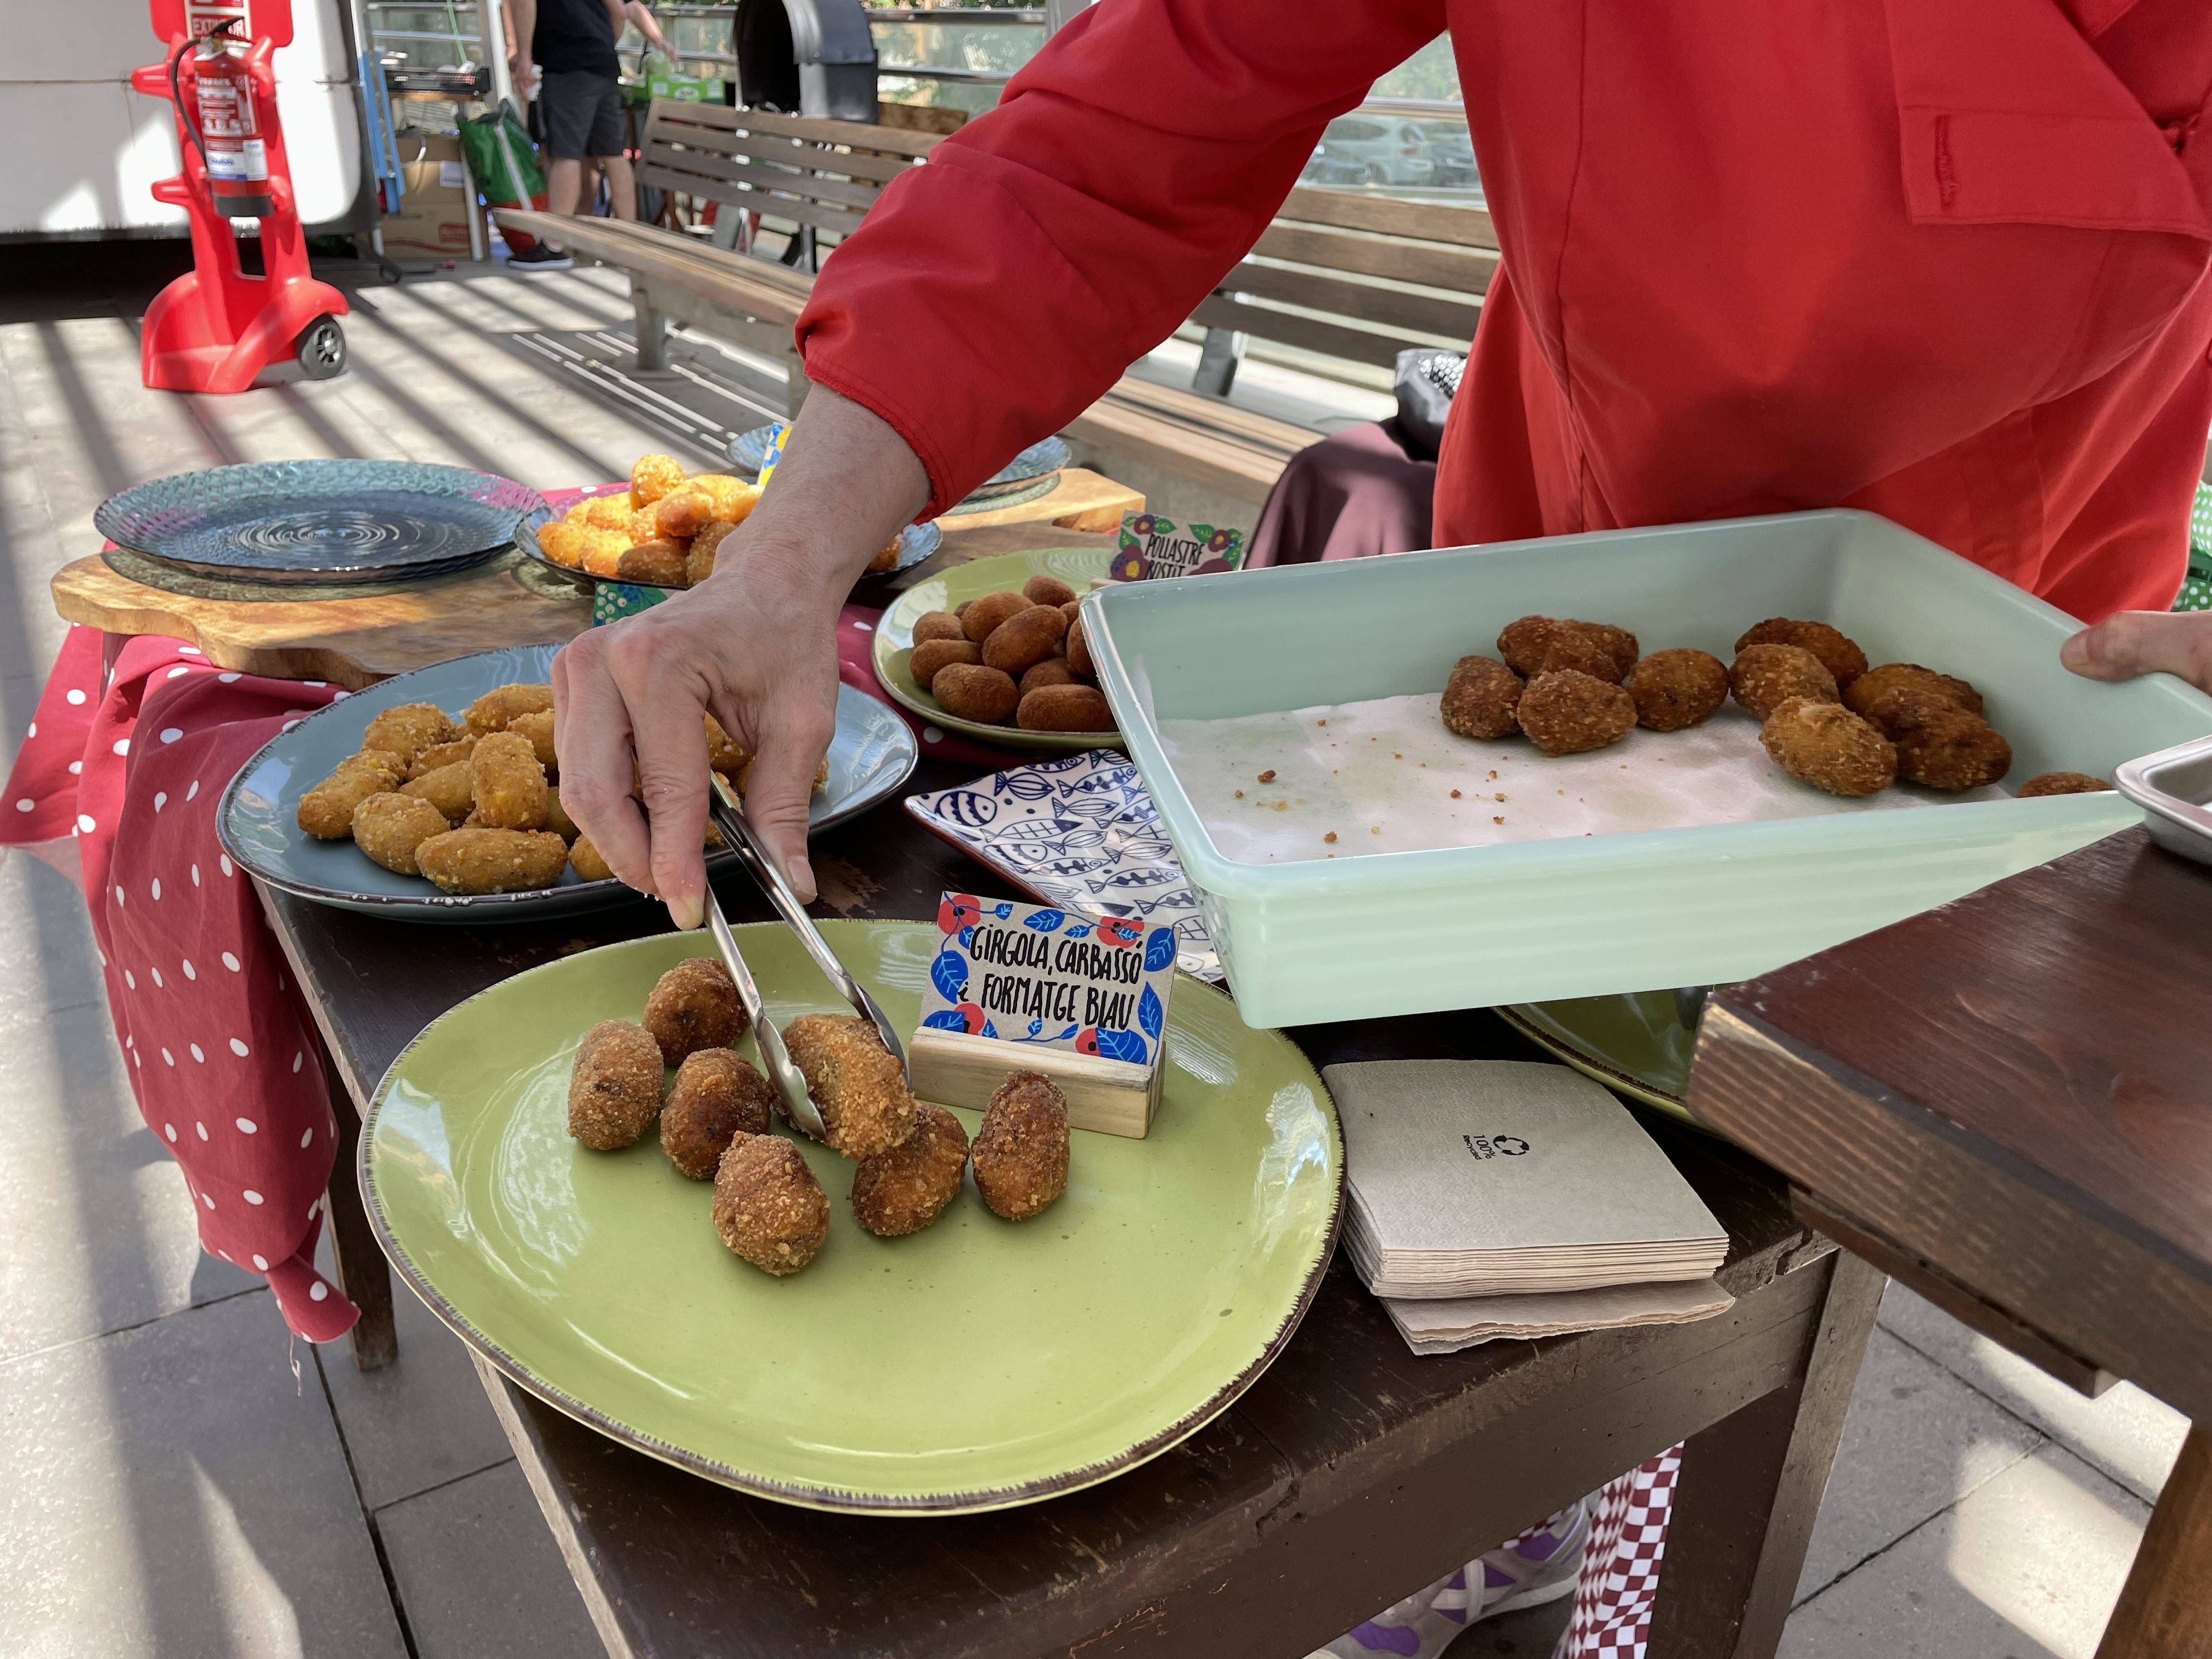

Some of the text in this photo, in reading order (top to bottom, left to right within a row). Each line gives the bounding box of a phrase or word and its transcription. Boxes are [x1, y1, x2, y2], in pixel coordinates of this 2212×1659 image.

[1145, 533, 1205, 565] POLLASTRE
[1055, 940, 1143, 984] CARBASSÓ
[981, 973, 1081, 1022] FORMATGE
[1085, 986, 1135, 1030] BLAU
[1473, 1135, 1497, 1159] 100%
